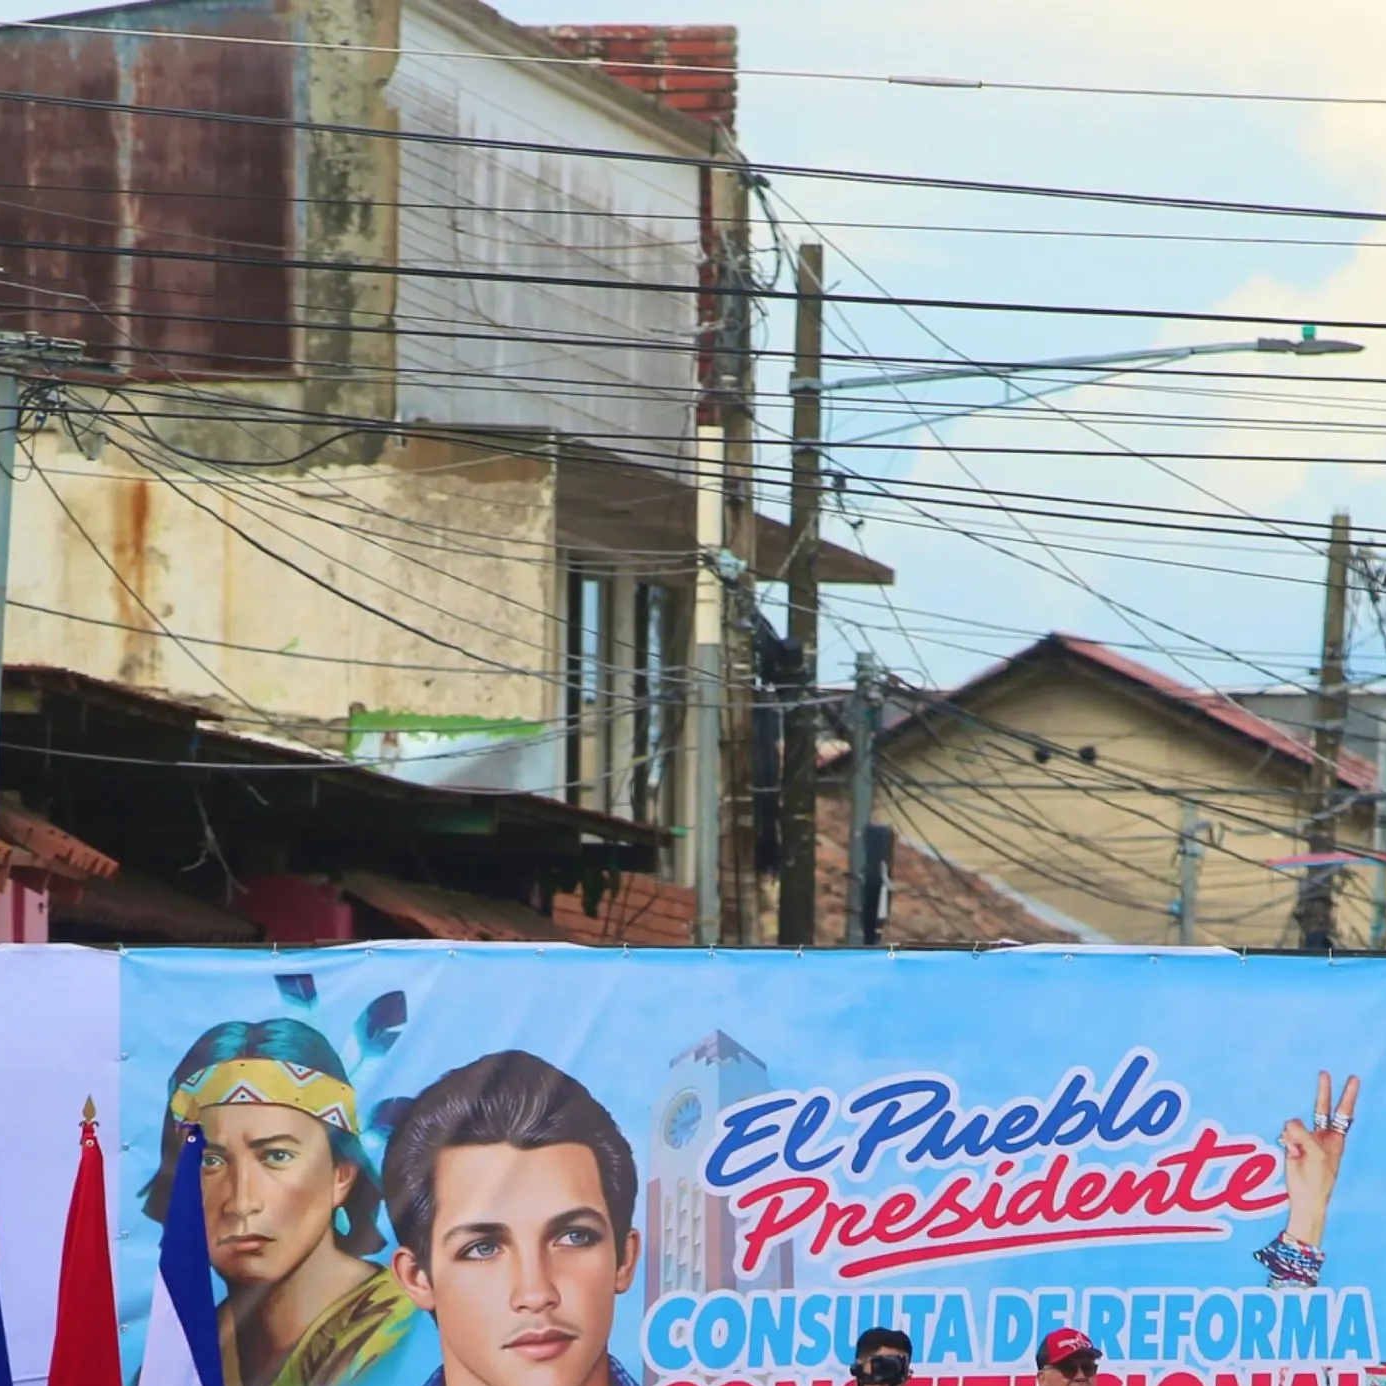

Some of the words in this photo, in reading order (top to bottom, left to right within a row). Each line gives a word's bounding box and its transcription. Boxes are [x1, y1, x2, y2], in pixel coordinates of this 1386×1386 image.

[705, 1096, 844, 1187] El
[849, 1054, 1182, 1174] Pueblo
[736, 1128, 1290, 1272] Presidente
[1087, 1293, 1373, 1361] REFORMA
